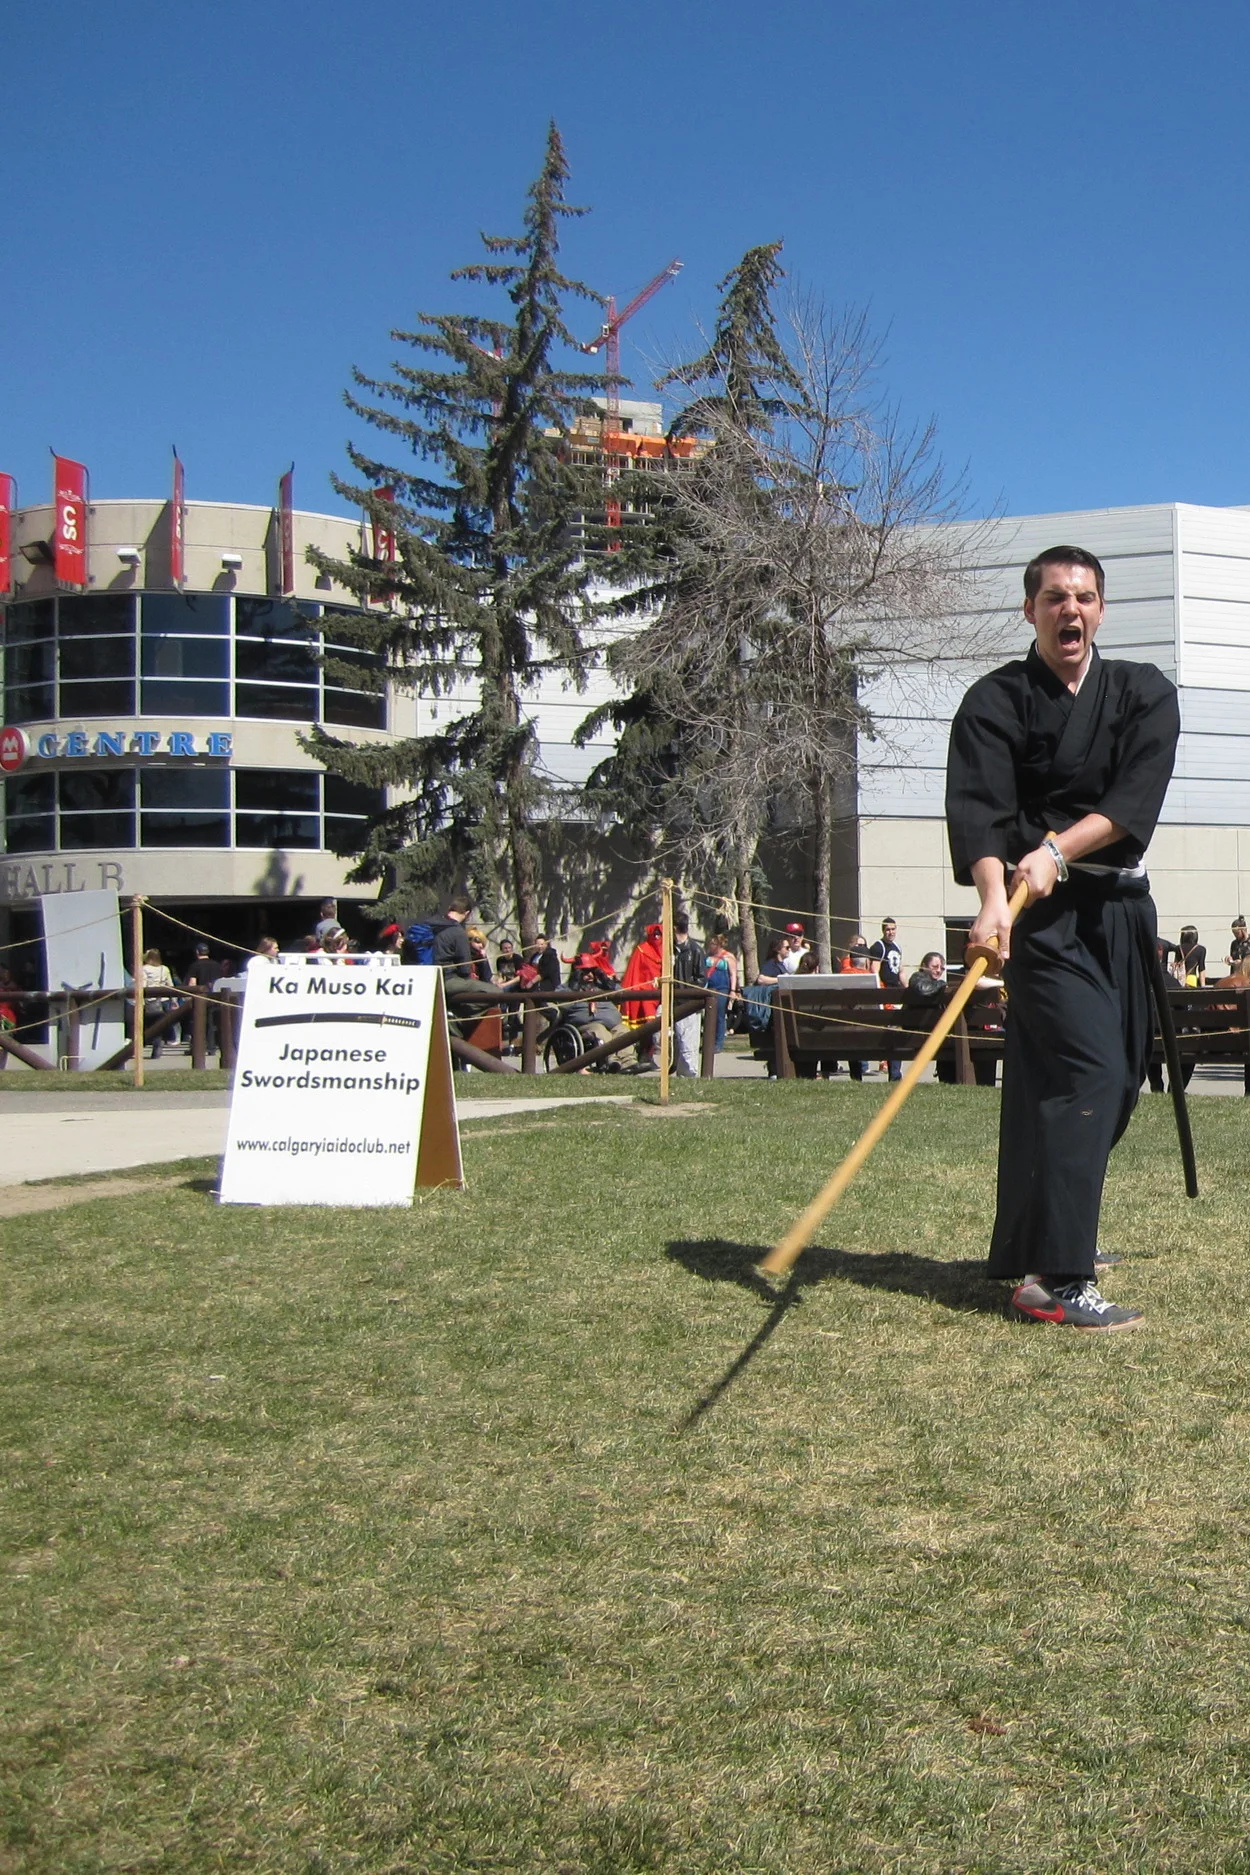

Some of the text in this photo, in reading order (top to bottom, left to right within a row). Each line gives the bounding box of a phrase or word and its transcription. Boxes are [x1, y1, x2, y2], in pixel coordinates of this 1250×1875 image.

[38, 731, 233, 758] CENTRE
[3, 863, 85, 897] HALL
[269, 976, 414, 996] Ka Muso Kai
[279, 1043, 387, 1065] Japanese
[241, 1070, 420, 1095] Swordsmanship
[237, 1136, 411, 1156] www.calgaryiaidoclub.net
